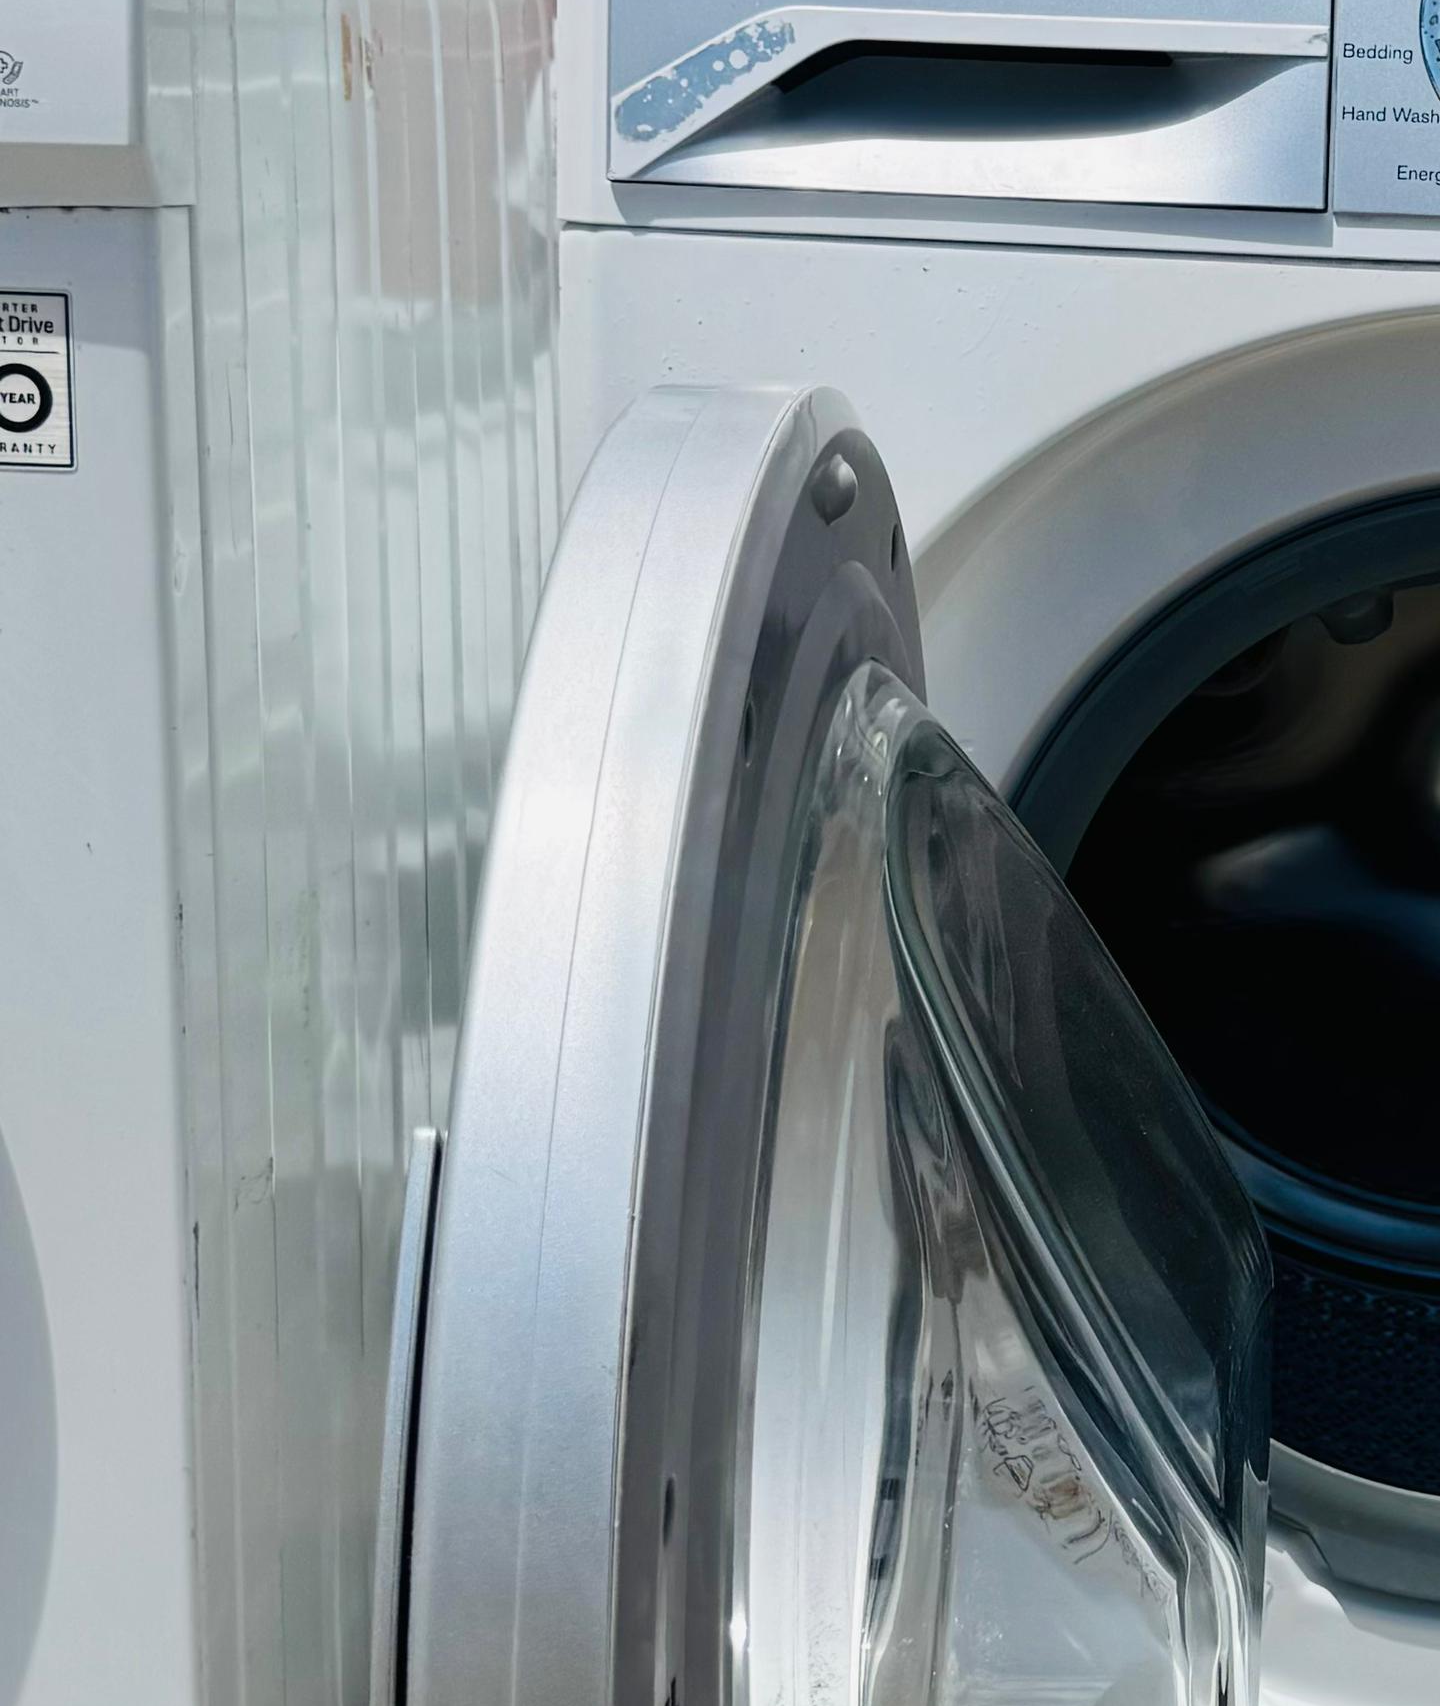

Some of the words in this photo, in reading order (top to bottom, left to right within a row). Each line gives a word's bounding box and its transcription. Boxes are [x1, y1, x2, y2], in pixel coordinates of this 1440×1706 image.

[1343, 43, 1413, 64] Bedding
[1342, 106, 1387, 123] Hand
[1393, 107, 1440, 124] Wash
[9, 315, 54, 333] Drive
[0, 392, 36, 404] YEAR
